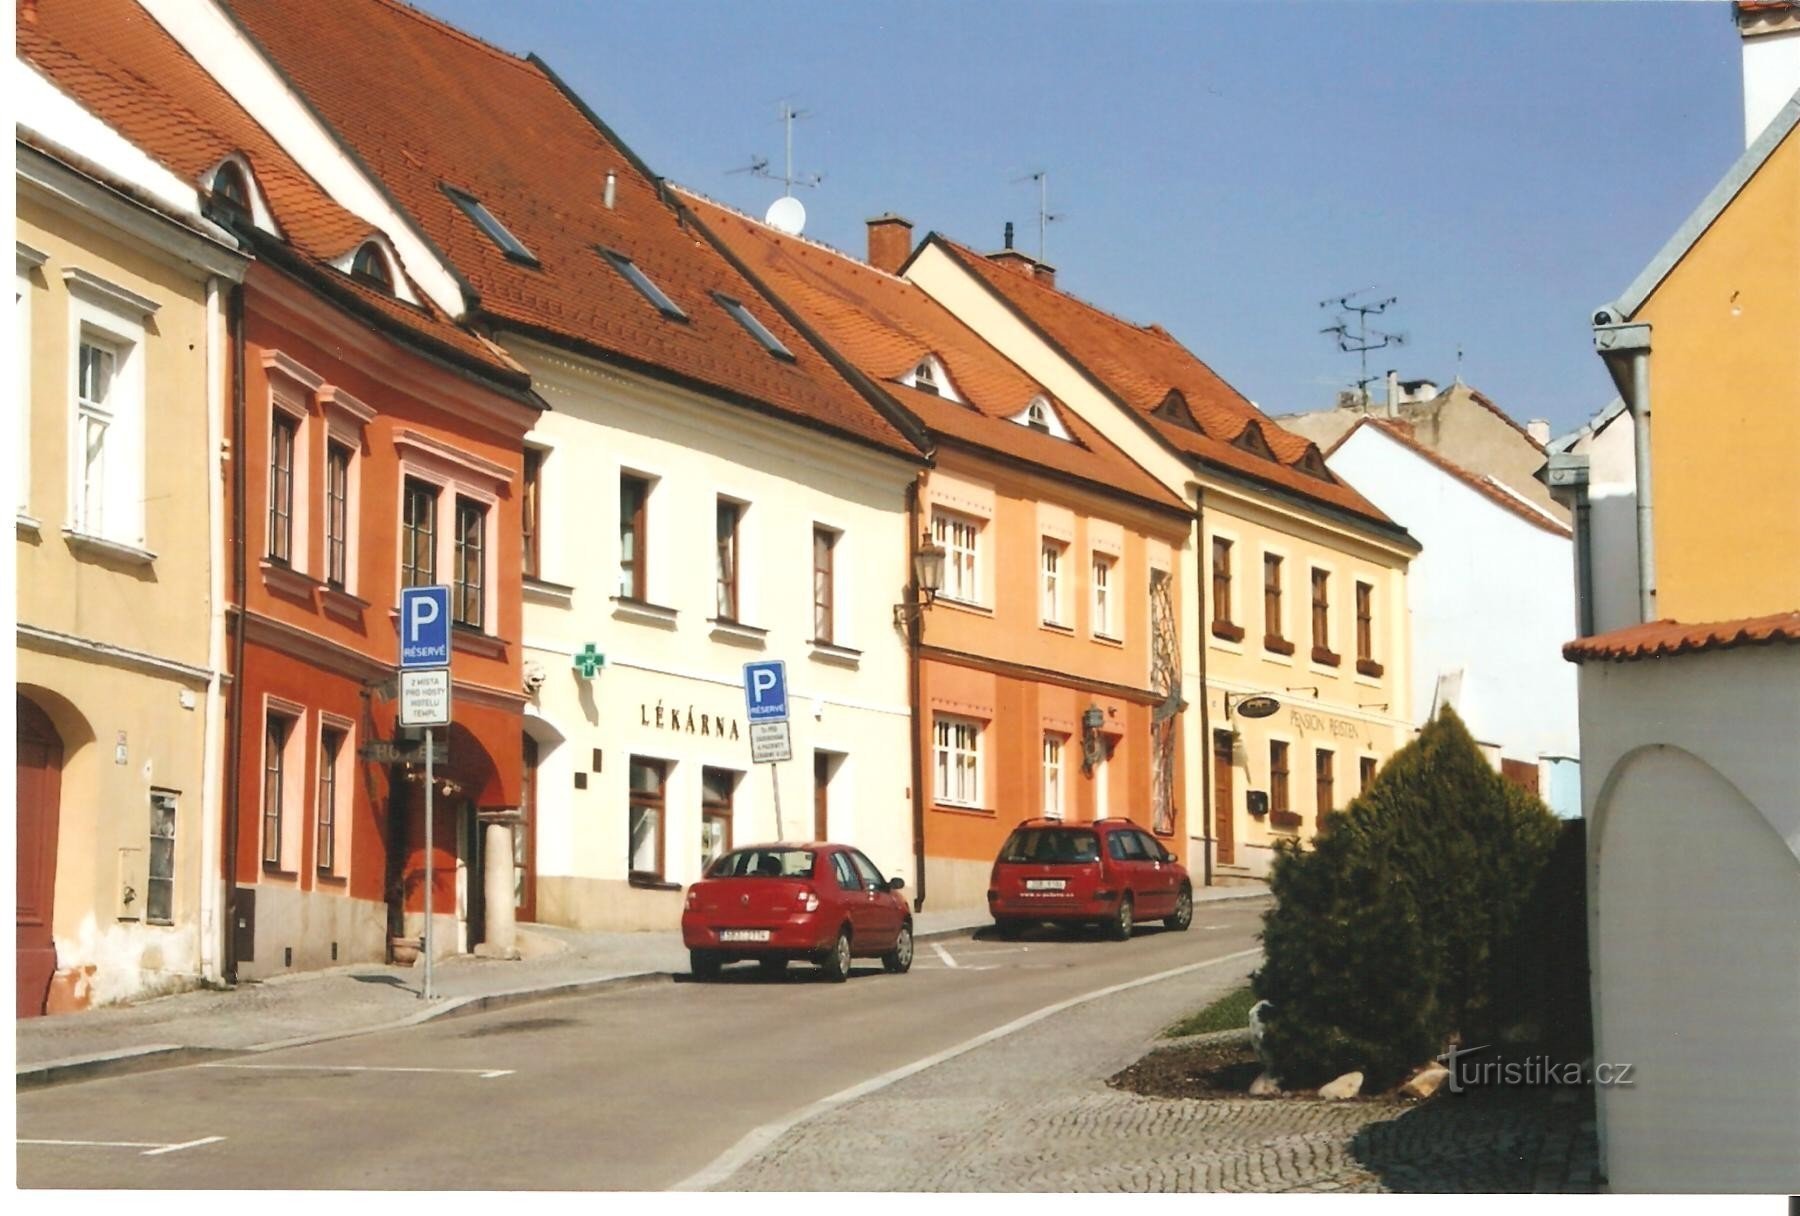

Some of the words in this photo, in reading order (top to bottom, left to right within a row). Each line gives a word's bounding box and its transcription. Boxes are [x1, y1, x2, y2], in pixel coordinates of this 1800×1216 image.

[411, 596, 439, 642] P
[404, 644, 446, 657] RÉSERVÉ
[752, 669, 777, 703] P
[641, 698, 740, 741] LÉKÁRNA
[375, 743, 440, 760] HOEL
